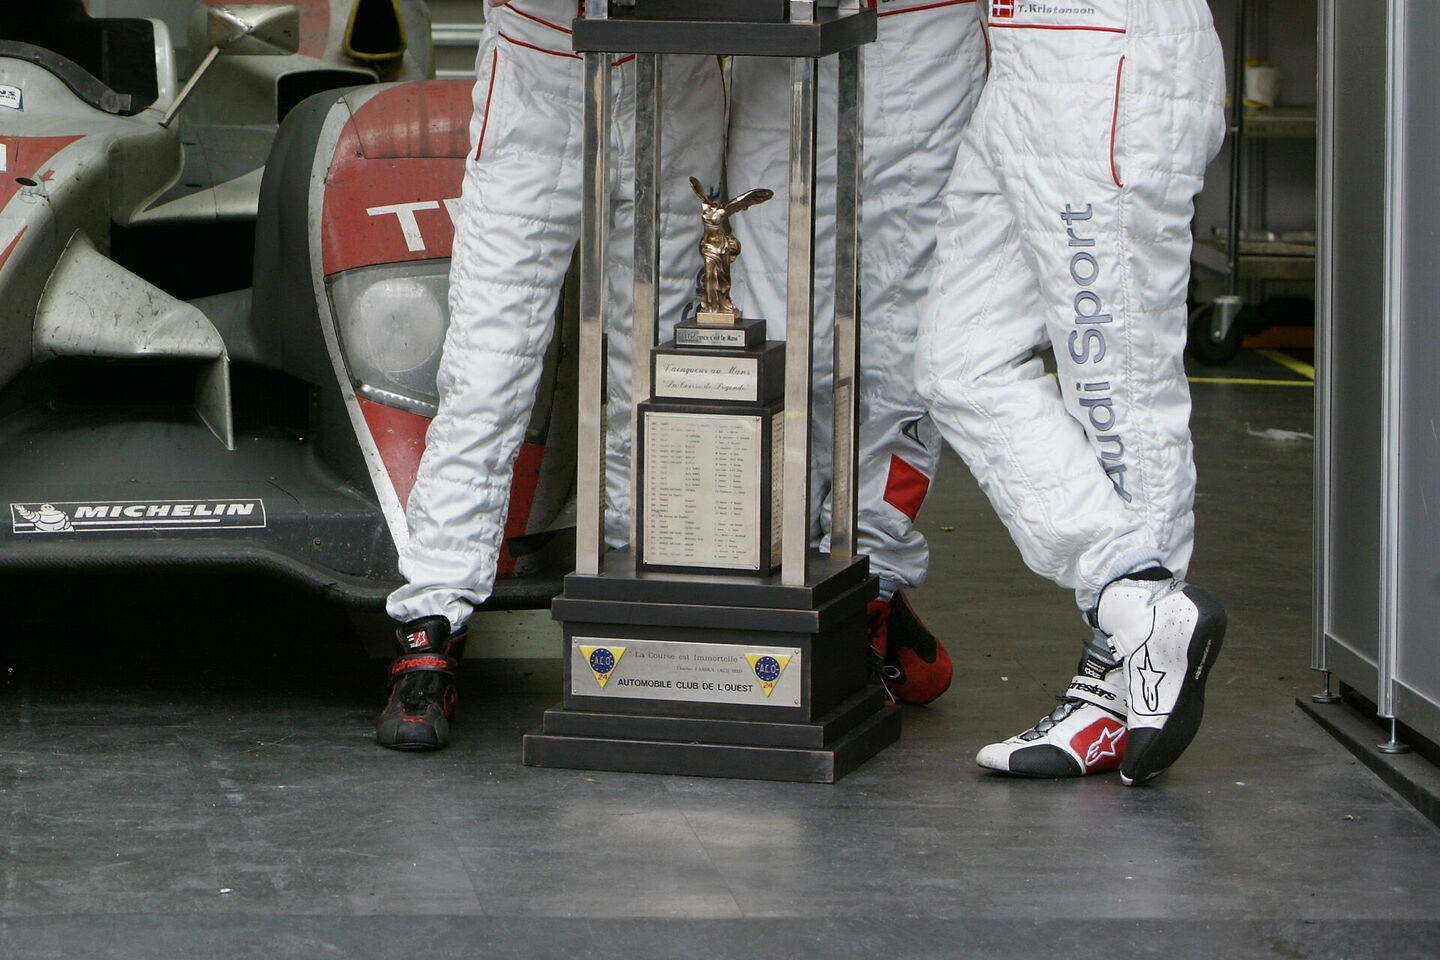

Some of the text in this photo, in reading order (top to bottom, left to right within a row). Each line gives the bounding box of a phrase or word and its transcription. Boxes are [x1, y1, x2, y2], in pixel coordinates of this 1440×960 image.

[1060, 202, 1113, 365] Sport
[74, 503, 255, 519] MICHELIN
[648, 652, 676, 661] Course
[679, 654, 690, 662] est
[617, 678, 753, 693] AUTOMOBILE CLUB DE L'OUEST
[762, 681, 773, 690] 24
